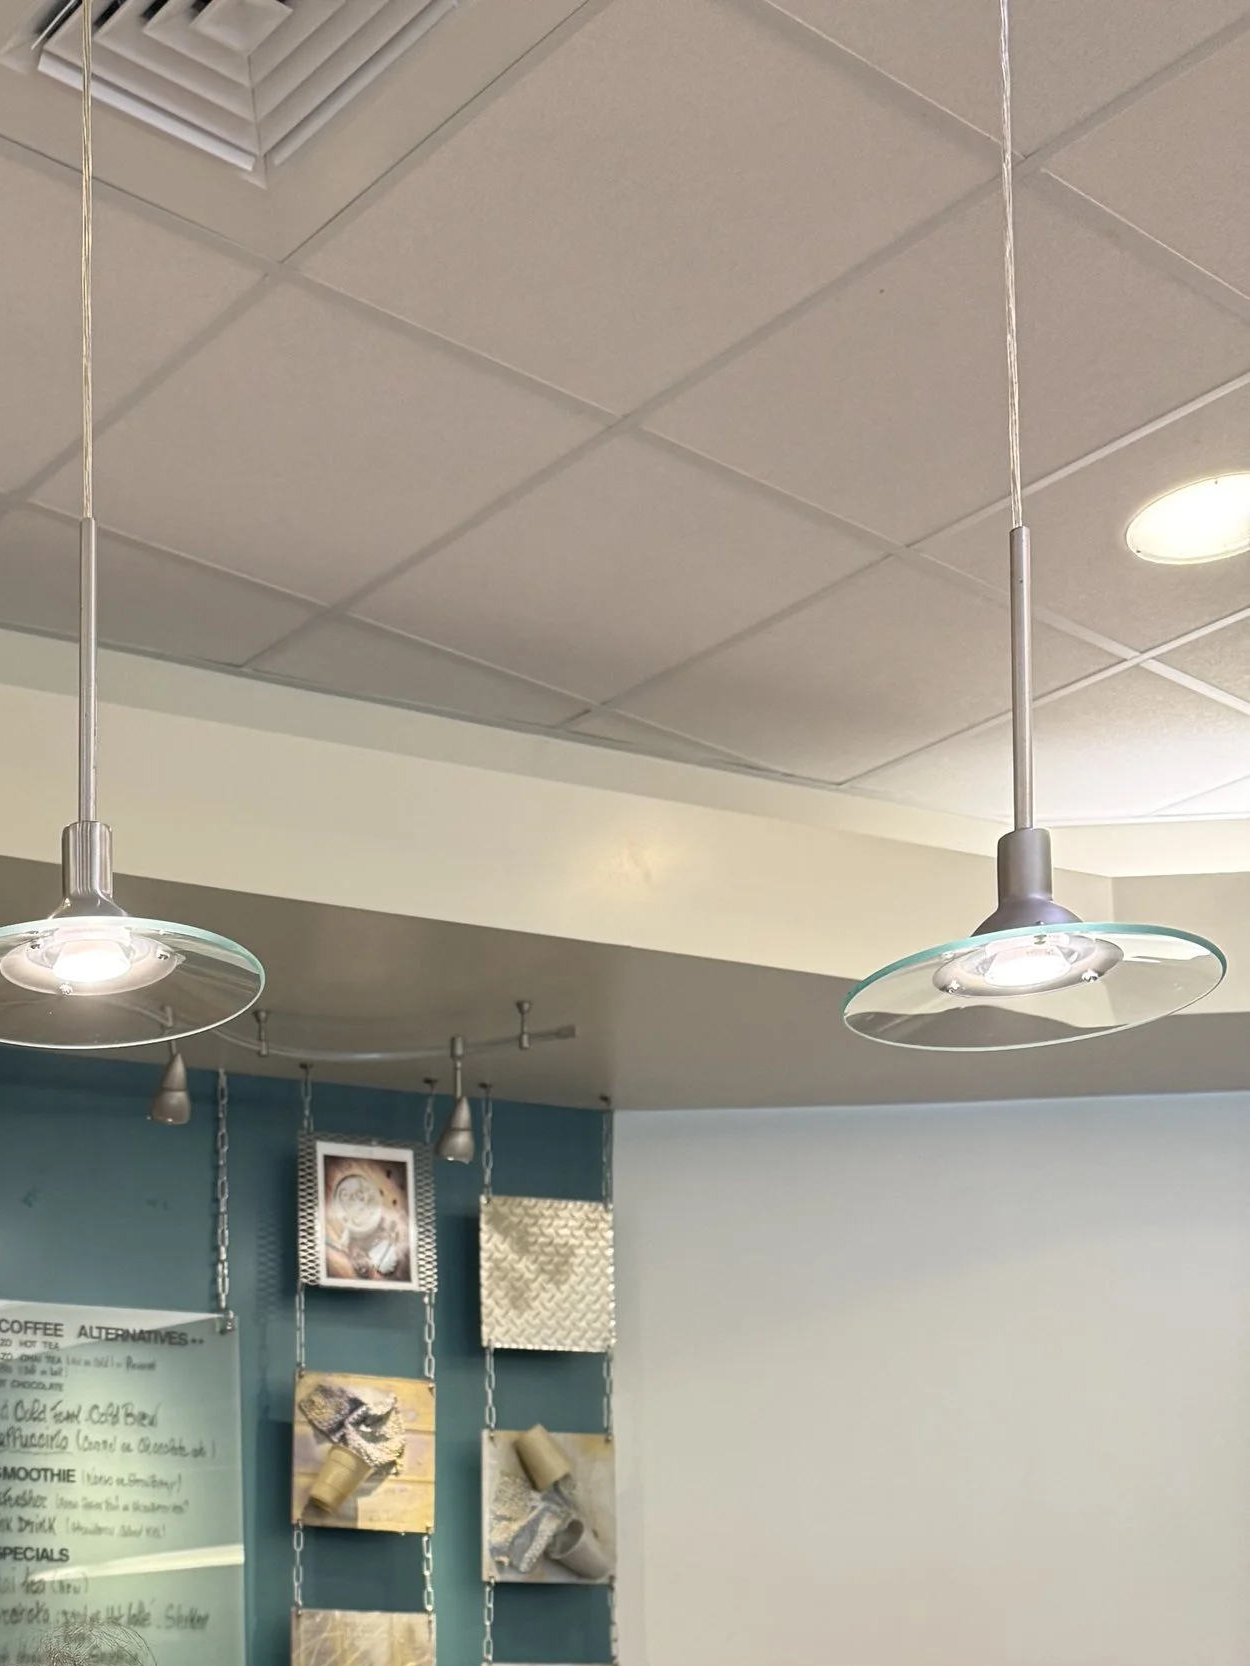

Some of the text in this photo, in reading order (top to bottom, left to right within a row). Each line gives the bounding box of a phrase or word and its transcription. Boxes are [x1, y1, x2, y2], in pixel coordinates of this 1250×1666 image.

[78, 1325, 189, 1346] ALTERNATIVES
[19, 1339, 37, 1348] HOT
[43, 1341, 60, 1350] TEA
